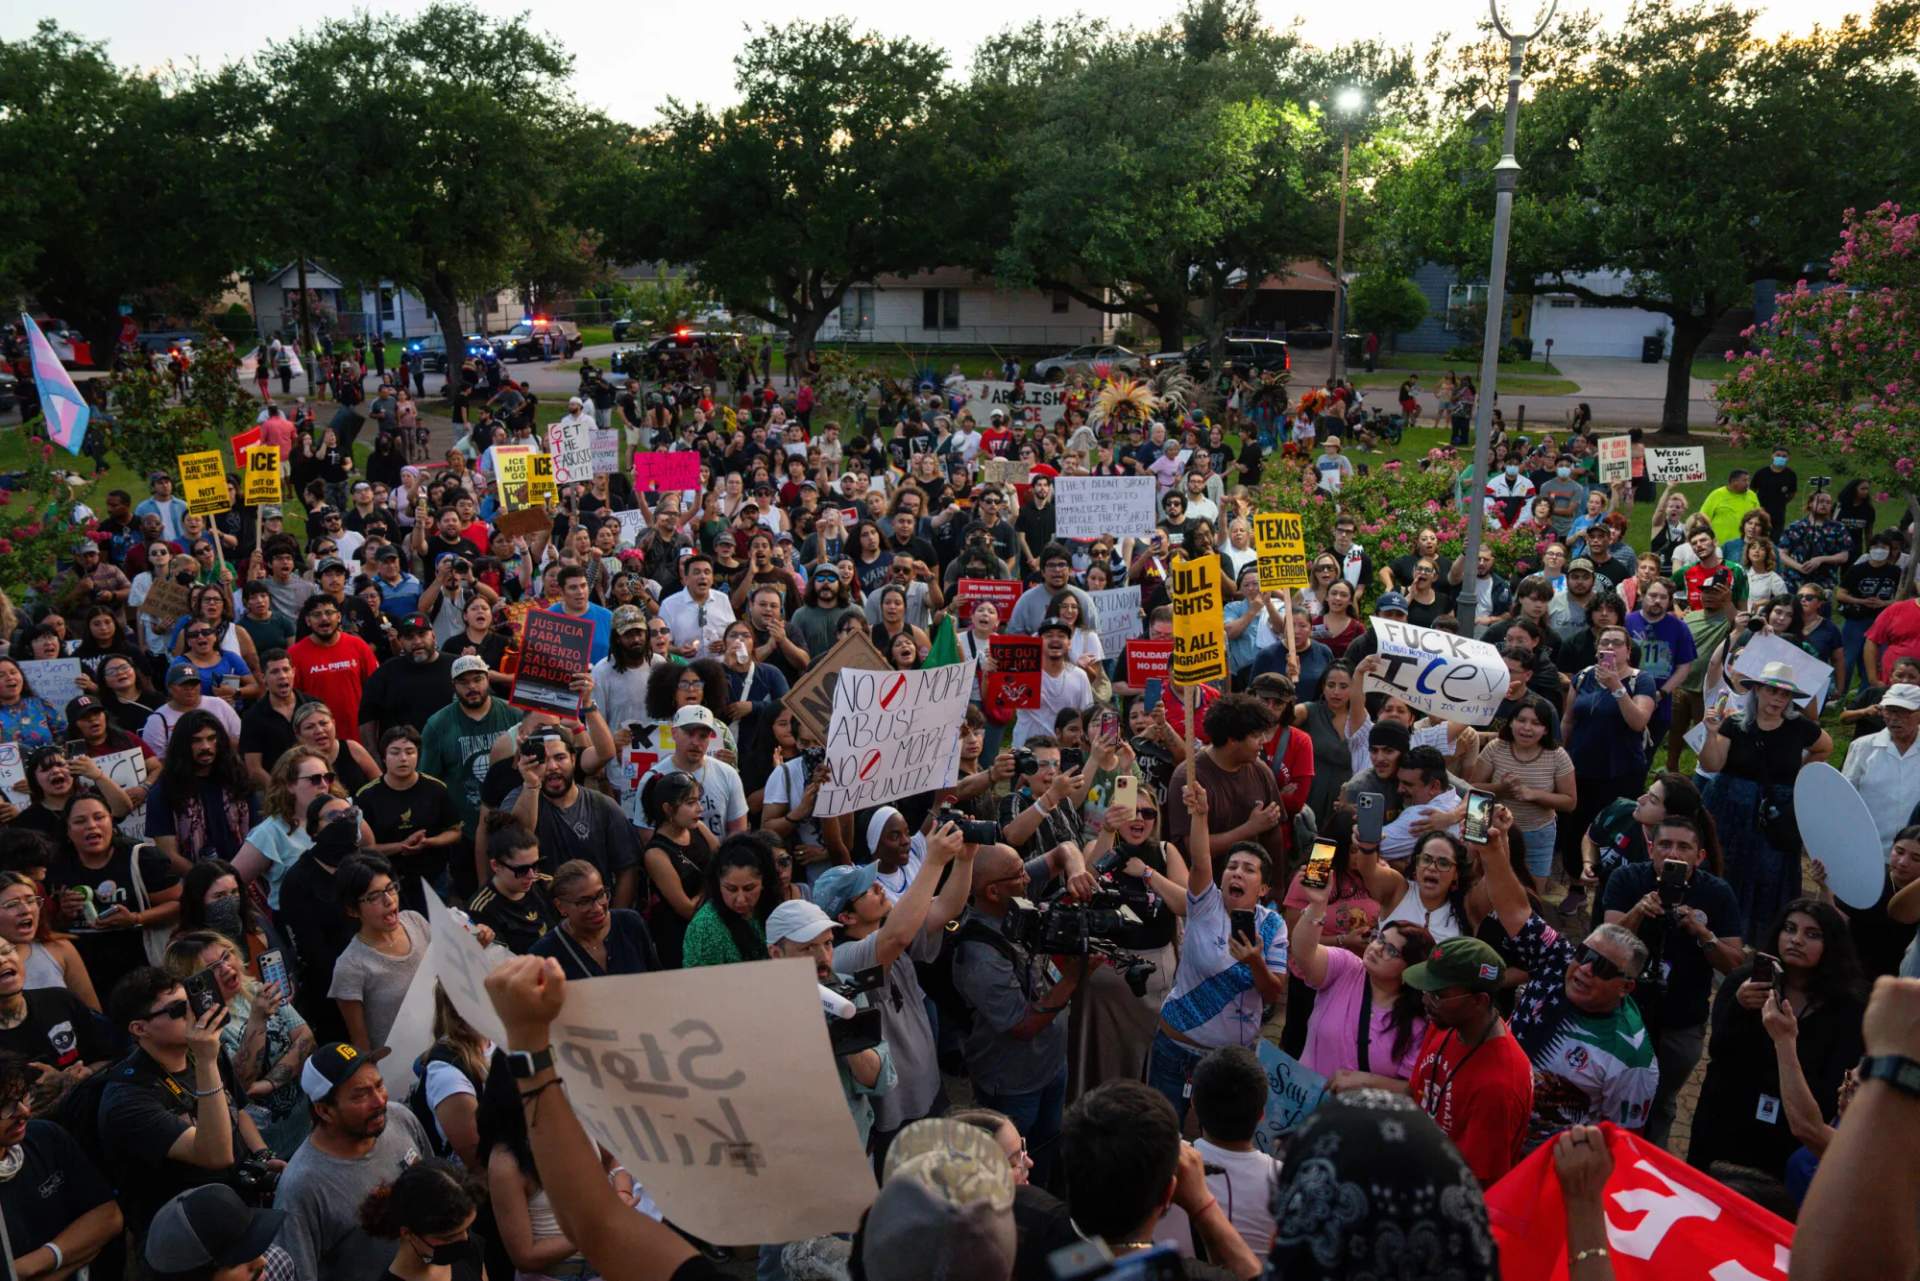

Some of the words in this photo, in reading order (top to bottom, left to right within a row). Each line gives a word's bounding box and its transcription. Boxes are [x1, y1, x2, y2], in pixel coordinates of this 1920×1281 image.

[251, 452, 277, 471] ICE
[1654, 448, 1692, 458] WRONG
[504, 464, 527, 473] MUS
[534, 457, 552, 477] ICE
[198, 486, 216, 498] NOT
[1256, 519, 1300, 542] TEXAS
[1259, 554, 1305, 565] STOP
[1173, 566, 1213, 595] ULL
[1259, 567, 1274, 579] ICE
[1276, 564, 1306, 578] TERROR
[1173, 593, 1214, 616] GHTS
[529, 629, 561, 644] PARA
[530, 618, 584, 637] JUSTICIA
[527, 640, 581, 660] LORENZO
[1190, 631, 1218, 652] ALL
[1384, 623, 1471, 660] FUCK
[994, 647, 1013, 658] ICE
[1016, 647, 1038, 658] OUT
[524, 653, 582, 673] SALGADO
[522, 665, 573, 683] ARAUJO
[834, 669, 876, 713] NO
[915, 662, 972, 707] MORE
[829, 706, 924, 749] ABUSE
[827, 754, 858, 788] NO
[891, 719, 955, 770] MORE
[1267, 1062, 1308, 1109] Say
